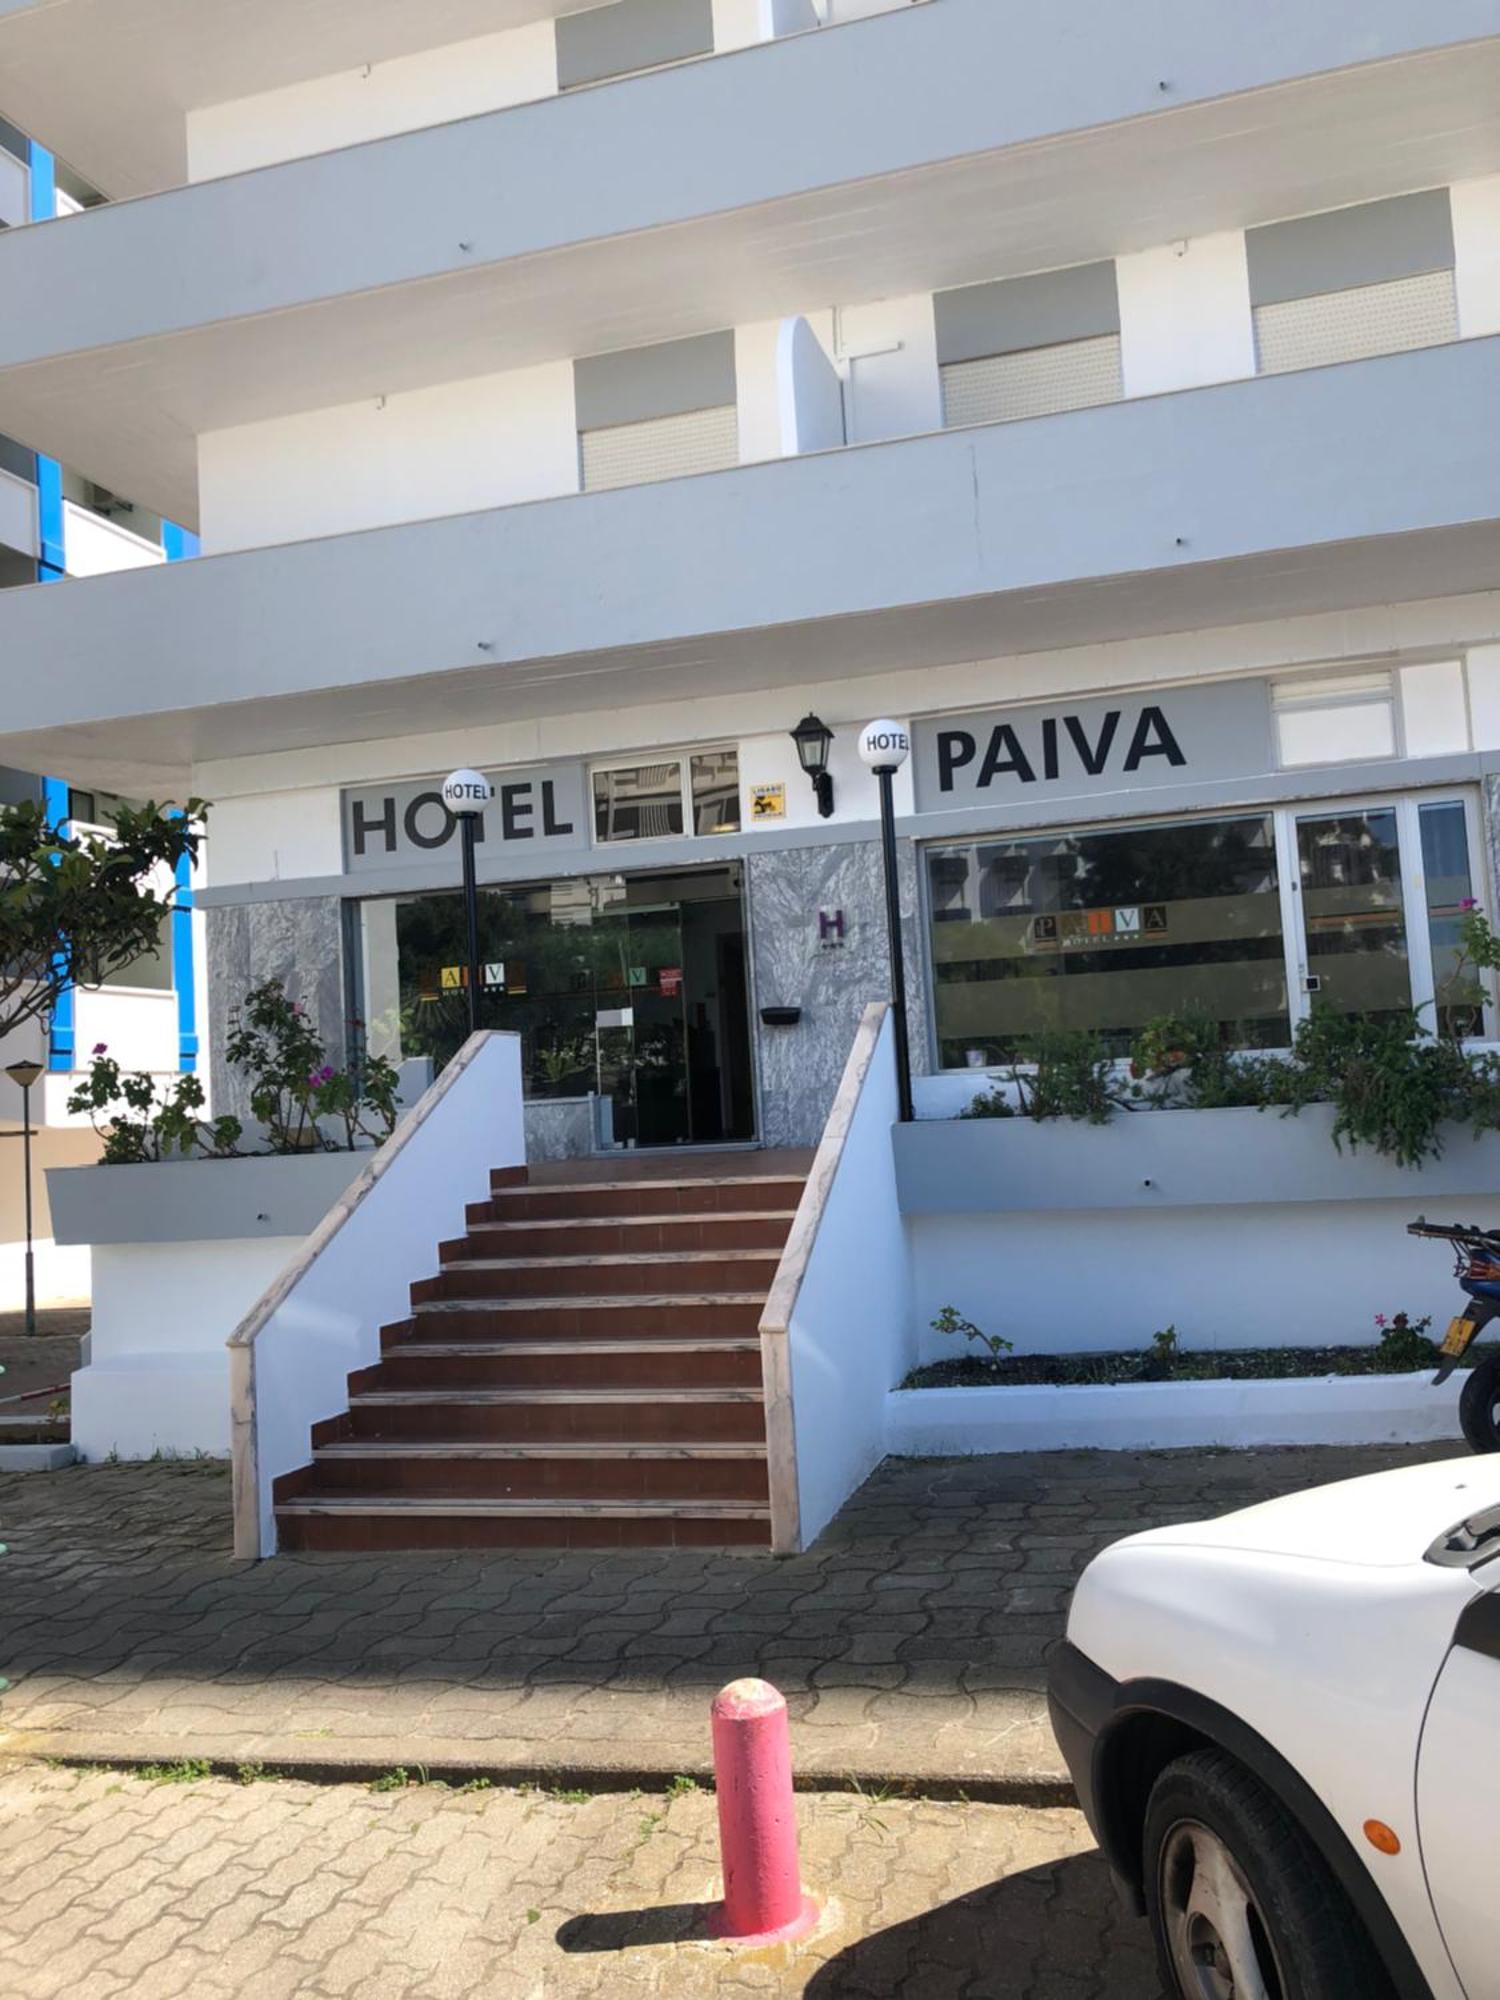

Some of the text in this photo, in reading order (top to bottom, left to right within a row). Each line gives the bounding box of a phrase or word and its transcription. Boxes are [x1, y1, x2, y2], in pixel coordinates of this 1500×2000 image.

[937, 706, 1187, 792] PAIVA
[445, 783, 488, 800] HOTEL
[819, 909, 844, 939] H
